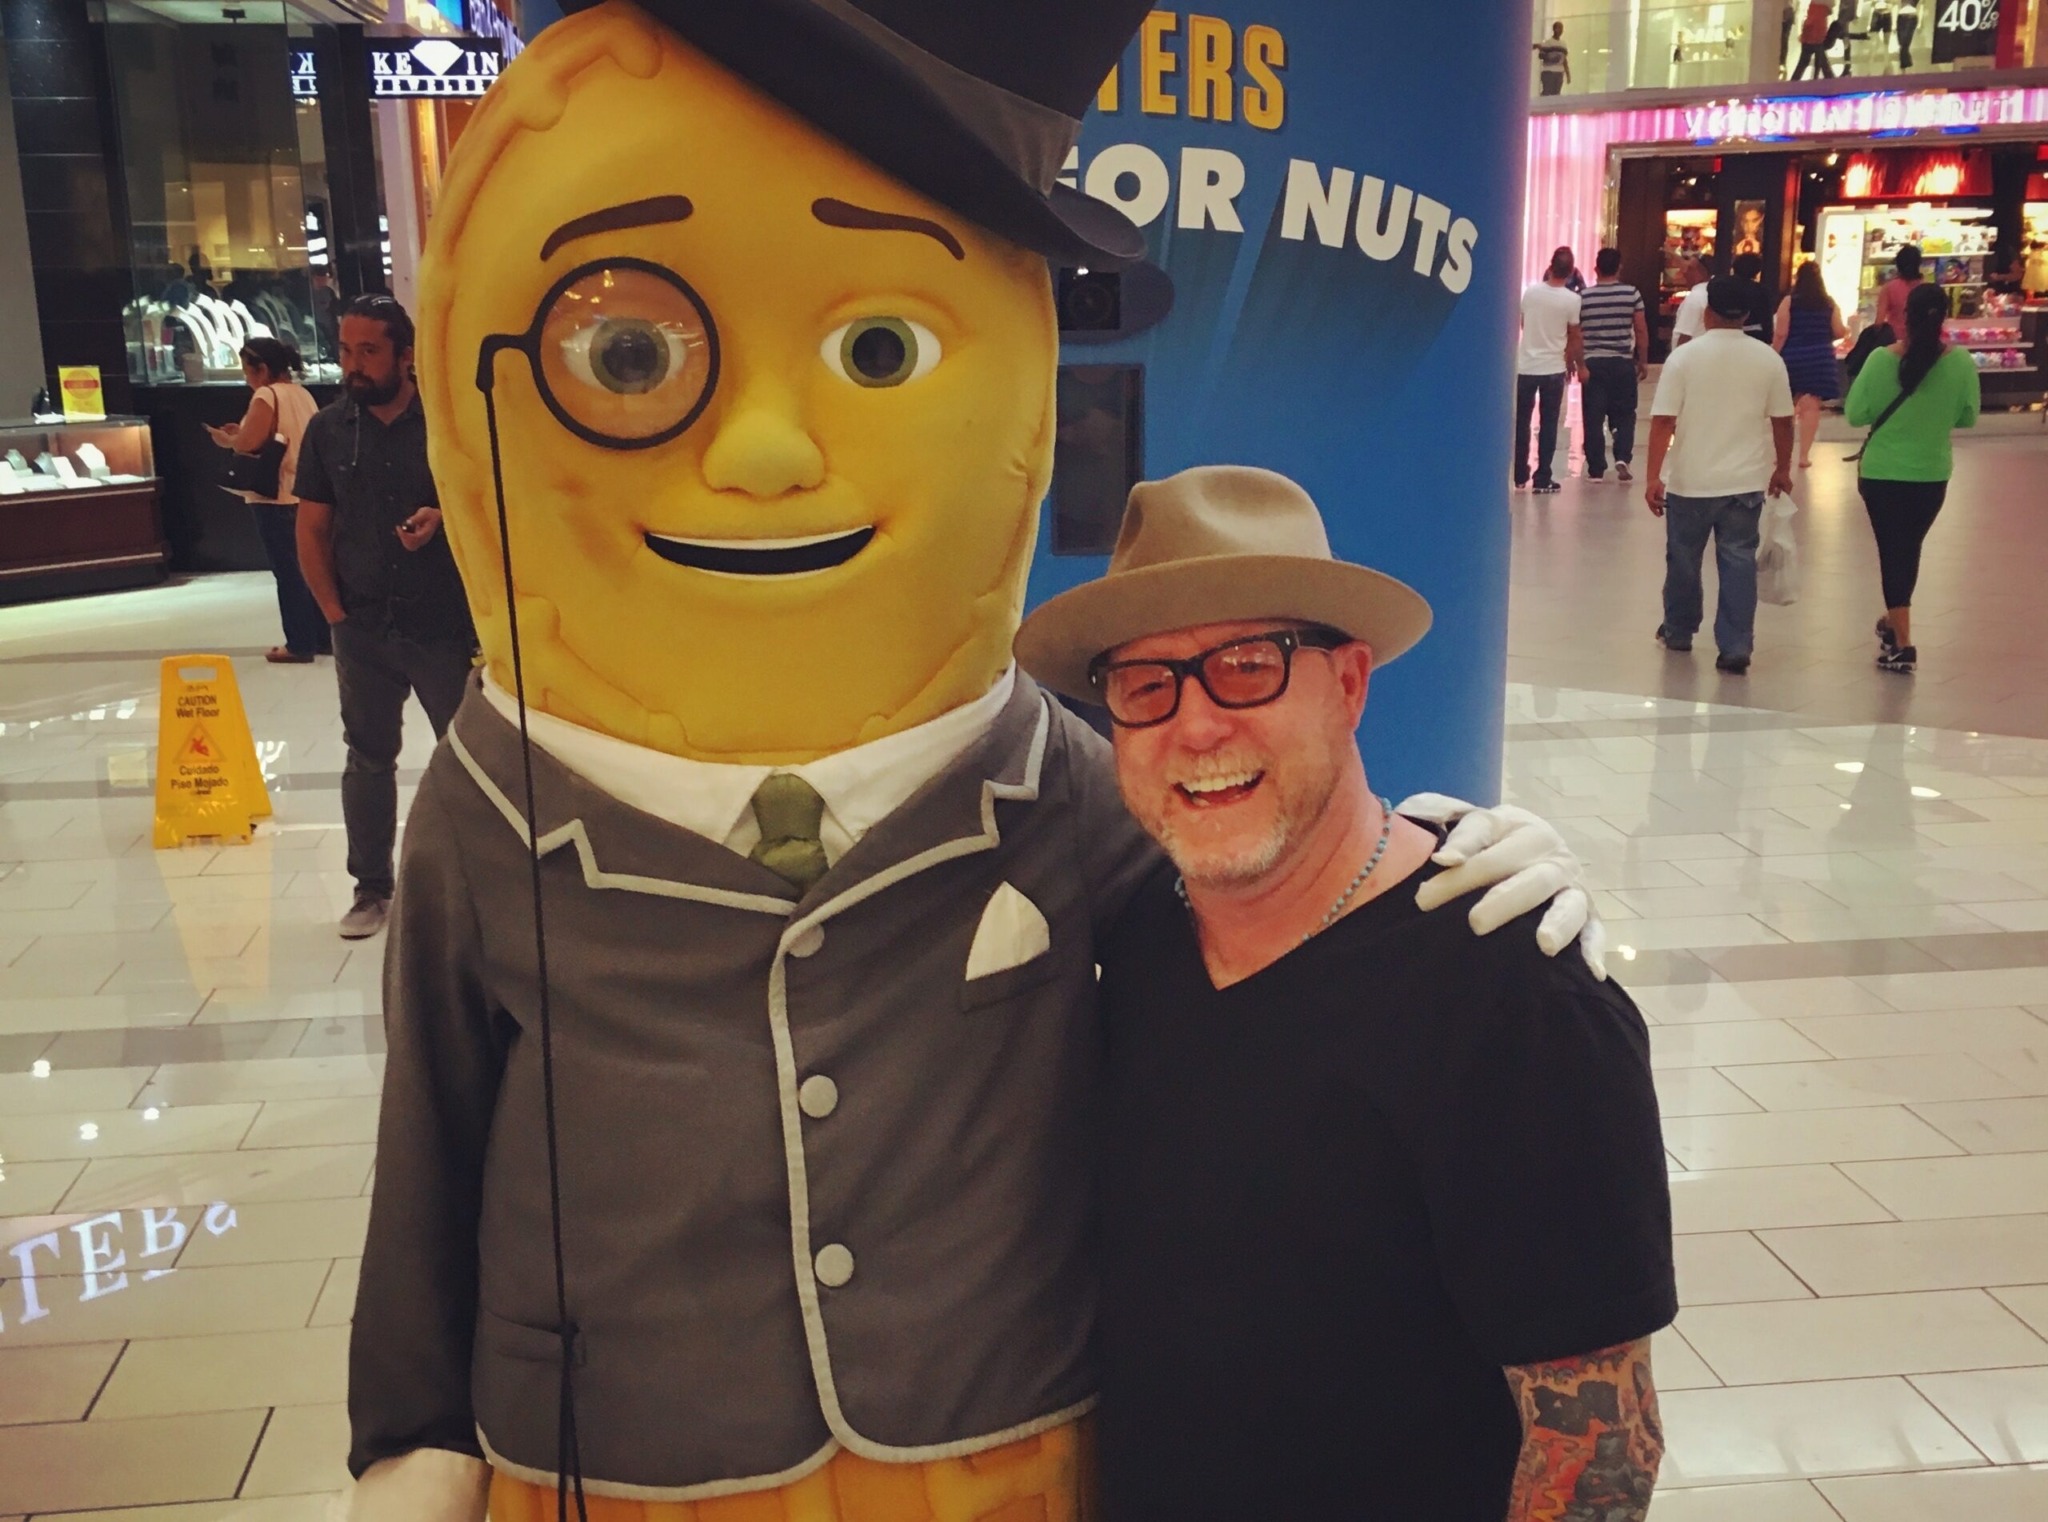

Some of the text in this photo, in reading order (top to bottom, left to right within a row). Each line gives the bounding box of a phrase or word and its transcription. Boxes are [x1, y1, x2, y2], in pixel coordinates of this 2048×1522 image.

[1281, 159, 1478, 294] NUTS
[178, 695, 217, 706] CAUTION
[177, 707, 220, 717] Wet Floor
[171, 778, 229, 789] Piso Mojado
